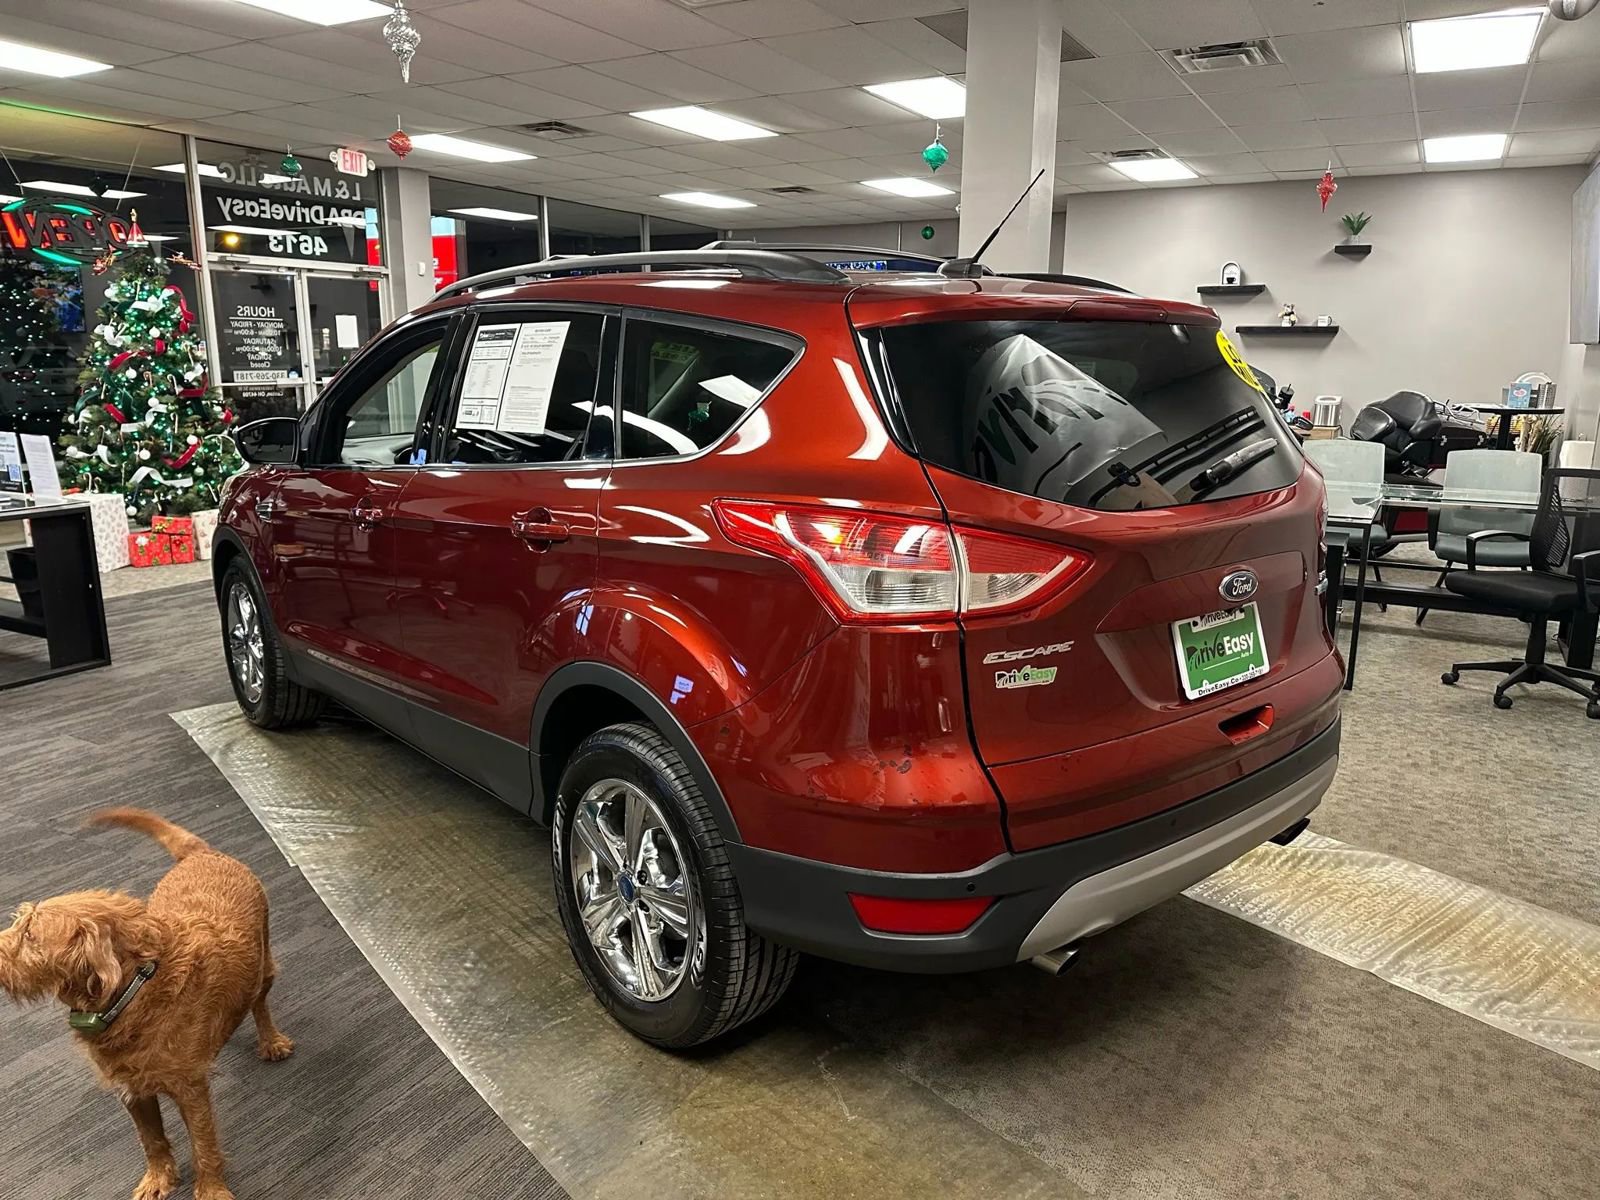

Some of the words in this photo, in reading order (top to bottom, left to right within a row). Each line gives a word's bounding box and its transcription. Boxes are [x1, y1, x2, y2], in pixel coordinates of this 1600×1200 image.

[342, 150, 364, 174] EXIT
[1232, 576, 1253, 595] Ford
[983, 640, 1075, 664] ESCAPE
[1185, 631, 1254, 672] DriveEasy
[996, 667, 1056, 687] DriveEasy
[1198, 681, 1230, 696] DriveEasy
